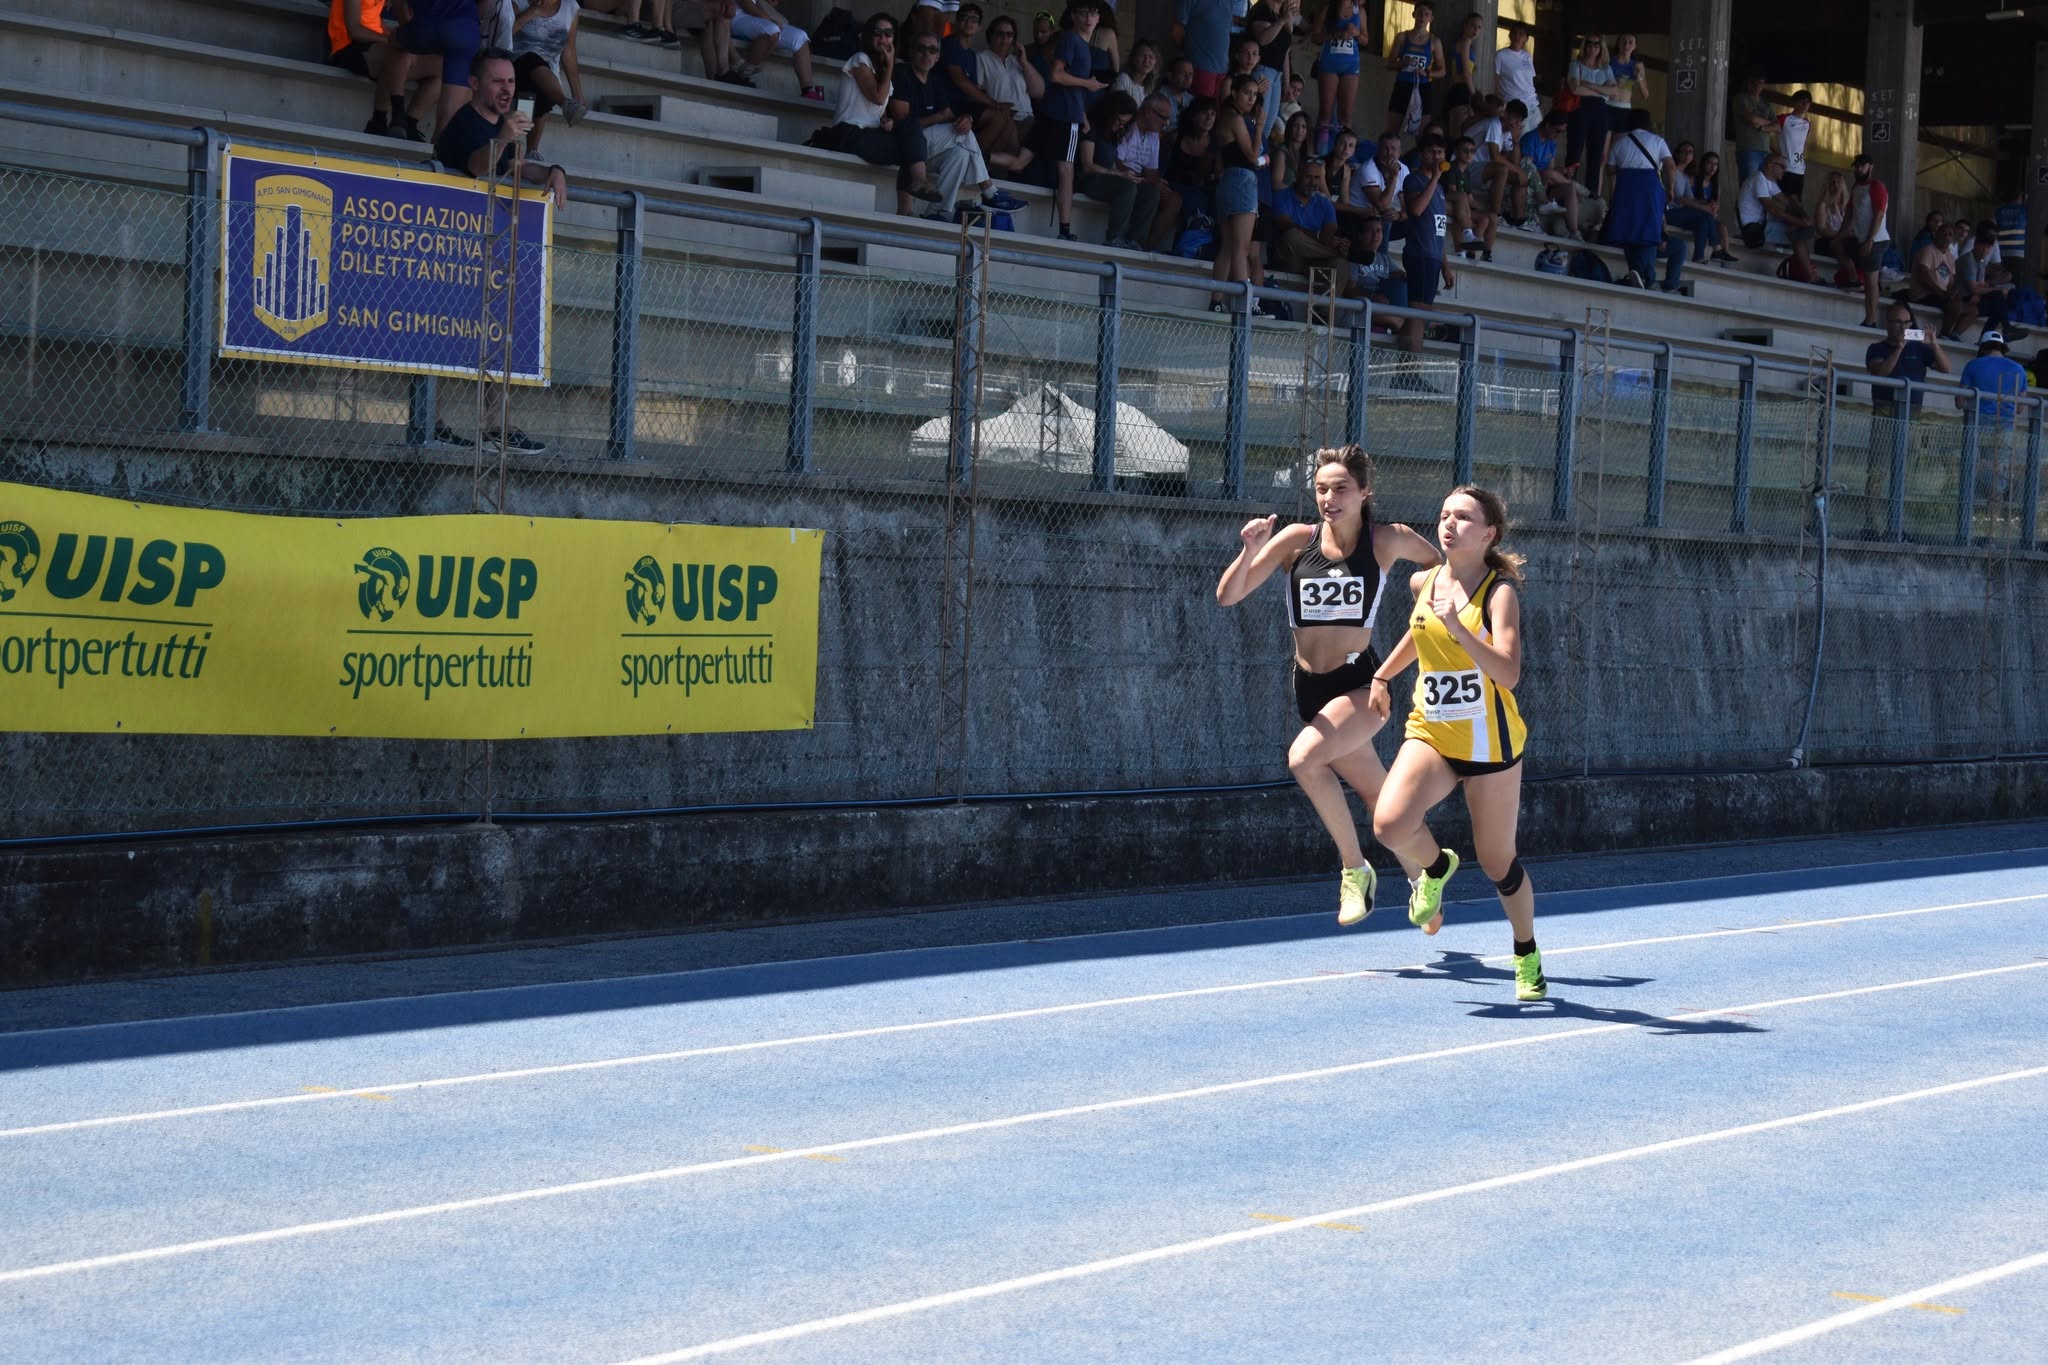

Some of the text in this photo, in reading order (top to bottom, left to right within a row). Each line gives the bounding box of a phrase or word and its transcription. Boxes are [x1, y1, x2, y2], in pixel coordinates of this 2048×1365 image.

[276, 186, 291, 194] SAN
[292, 187, 331, 206] GIMIGNANO
[342, 224, 484, 260] POLISPORTIVA
[340, 251, 512, 289] DILETTANTISTC
[338, 305, 503, 342] SAN GIMIGNANO
[1, 523, 26, 533] UISP
[45, 533, 226, 608] UISP
[416, 554, 538, 619] UISP
[672, 563, 778, 622] UISP
[1302, 581, 1362, 606] 326
[0, 627, 211, 689] ortpertutti
[339, 641, 533, 700] sportpertutti
[621, 641, 773, 698] sportpertutti
[1424, 673, 1482, 706] 325
